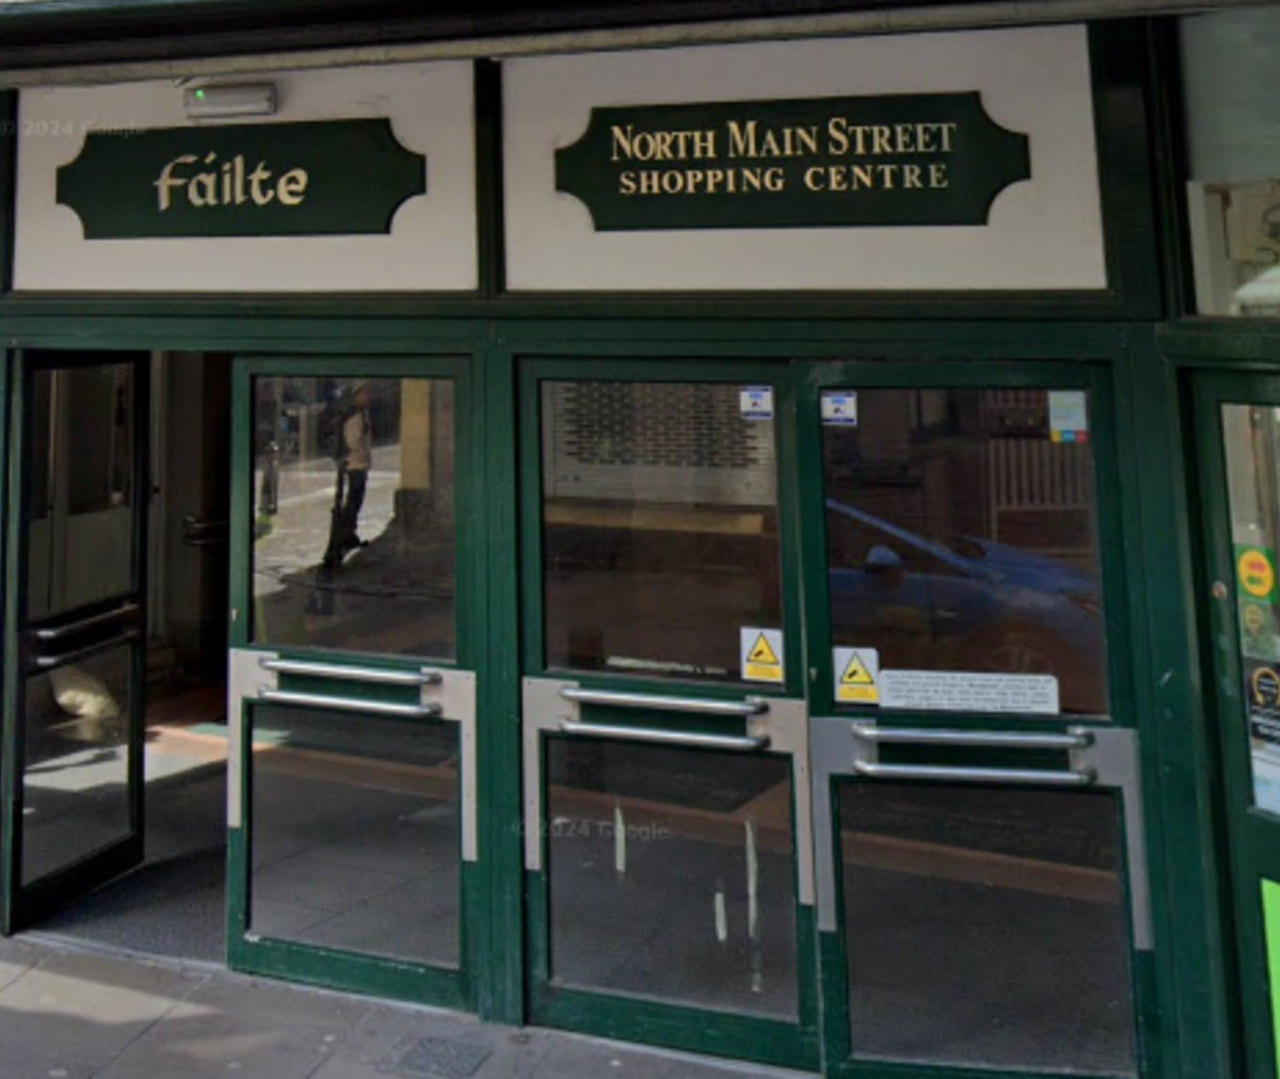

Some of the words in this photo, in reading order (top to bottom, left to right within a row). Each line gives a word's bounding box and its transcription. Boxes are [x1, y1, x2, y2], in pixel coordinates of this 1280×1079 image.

[610, 124, 717, 161] NORTH
[727, 120, 819, 158] MAIN
[827, 117, 956, 156] STREET
[619, 166, 786, 195] SHOPPING
[803, 163, 949, 191] CENTRE
